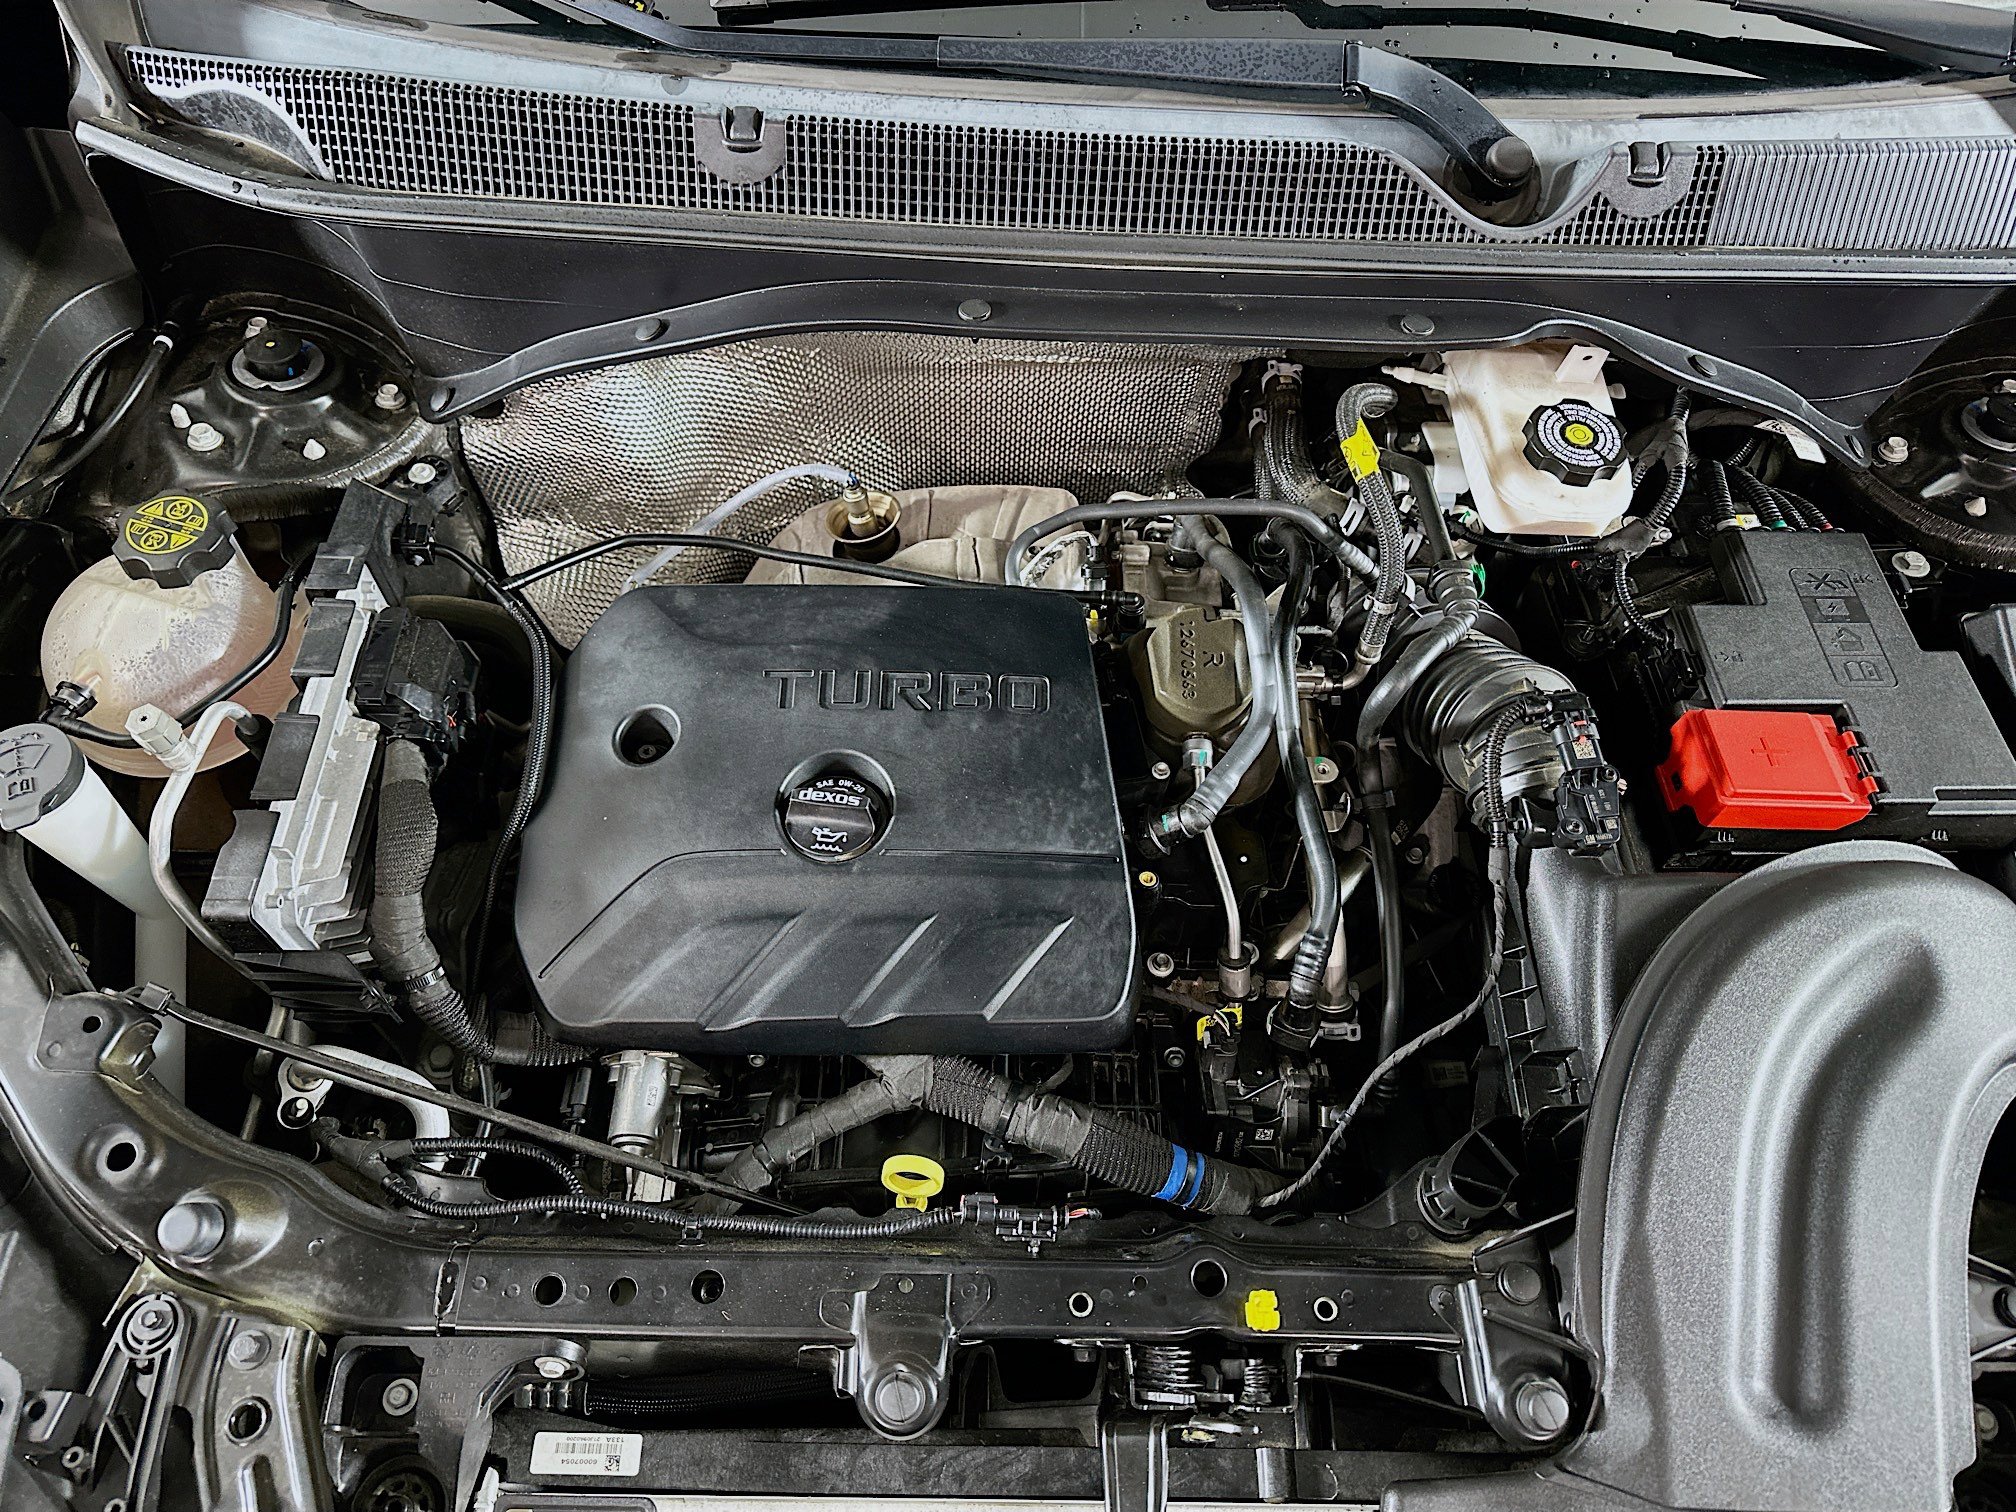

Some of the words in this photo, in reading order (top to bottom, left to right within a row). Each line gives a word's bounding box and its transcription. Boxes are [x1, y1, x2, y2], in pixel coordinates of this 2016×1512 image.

[1203, 651, 1225, 667] R
[762, 669, 1050, 713] TURBO
[816, 779, 835, 789] SAE
[798, 787, 863, 807] dexos
